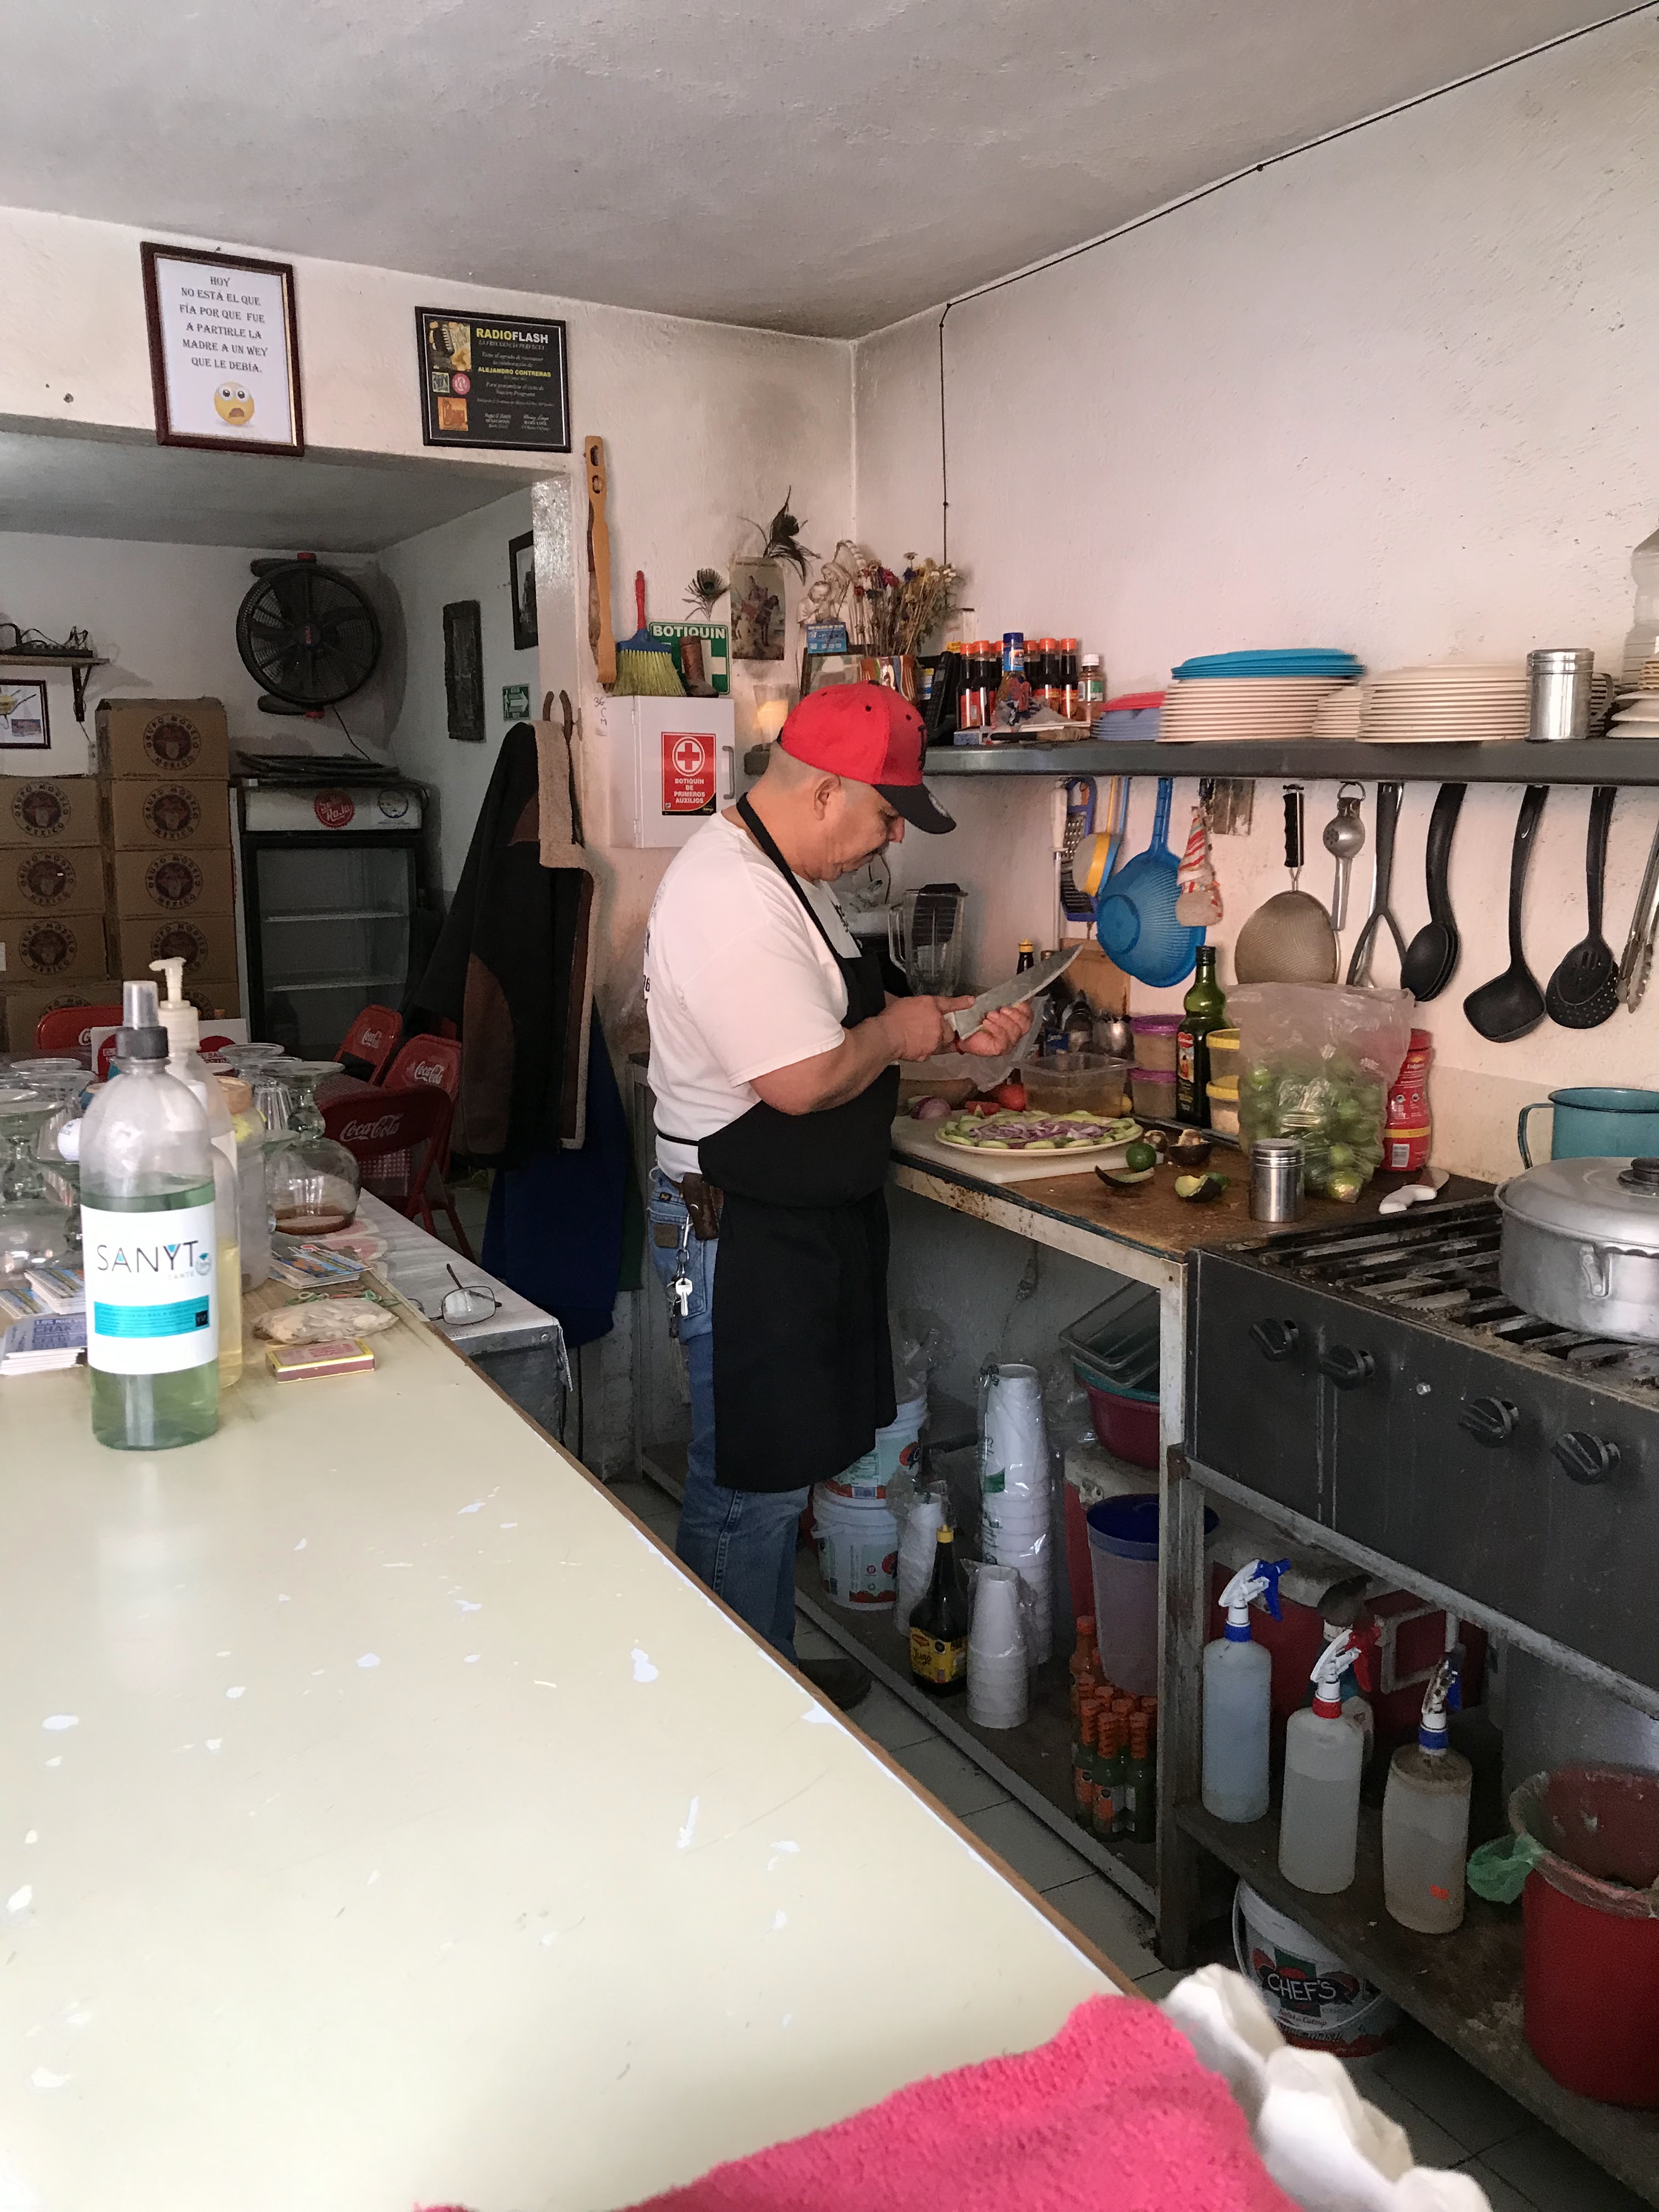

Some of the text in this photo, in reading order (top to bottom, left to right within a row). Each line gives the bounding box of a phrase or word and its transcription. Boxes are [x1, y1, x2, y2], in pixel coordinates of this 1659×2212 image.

[210, 276, 230, 287] HOY
[181, 287, 194, 297] NO
[226, 293, 239, 303] EL
[241, 295, 261, 306] QUE
[179, 303, 265, 323] FÍA POR QUE FUE
[186, 323, 262, 339] A PARTIRLE LA
[476, 328, 548, 343] RADIOFLASH
[183, 338, 268, 357] MADRE A UN WEY
[191, 357, 212, 367] QUE
[215, 359, 227, 369] LE
[478, 366, 514, 375] ALEJANDRO
[653, 625, 725, 639] BOTIQUIN
[913, 1649, 932, 1664] Jugo
[1268, 1973, 1336, 2001] CHEF'S
